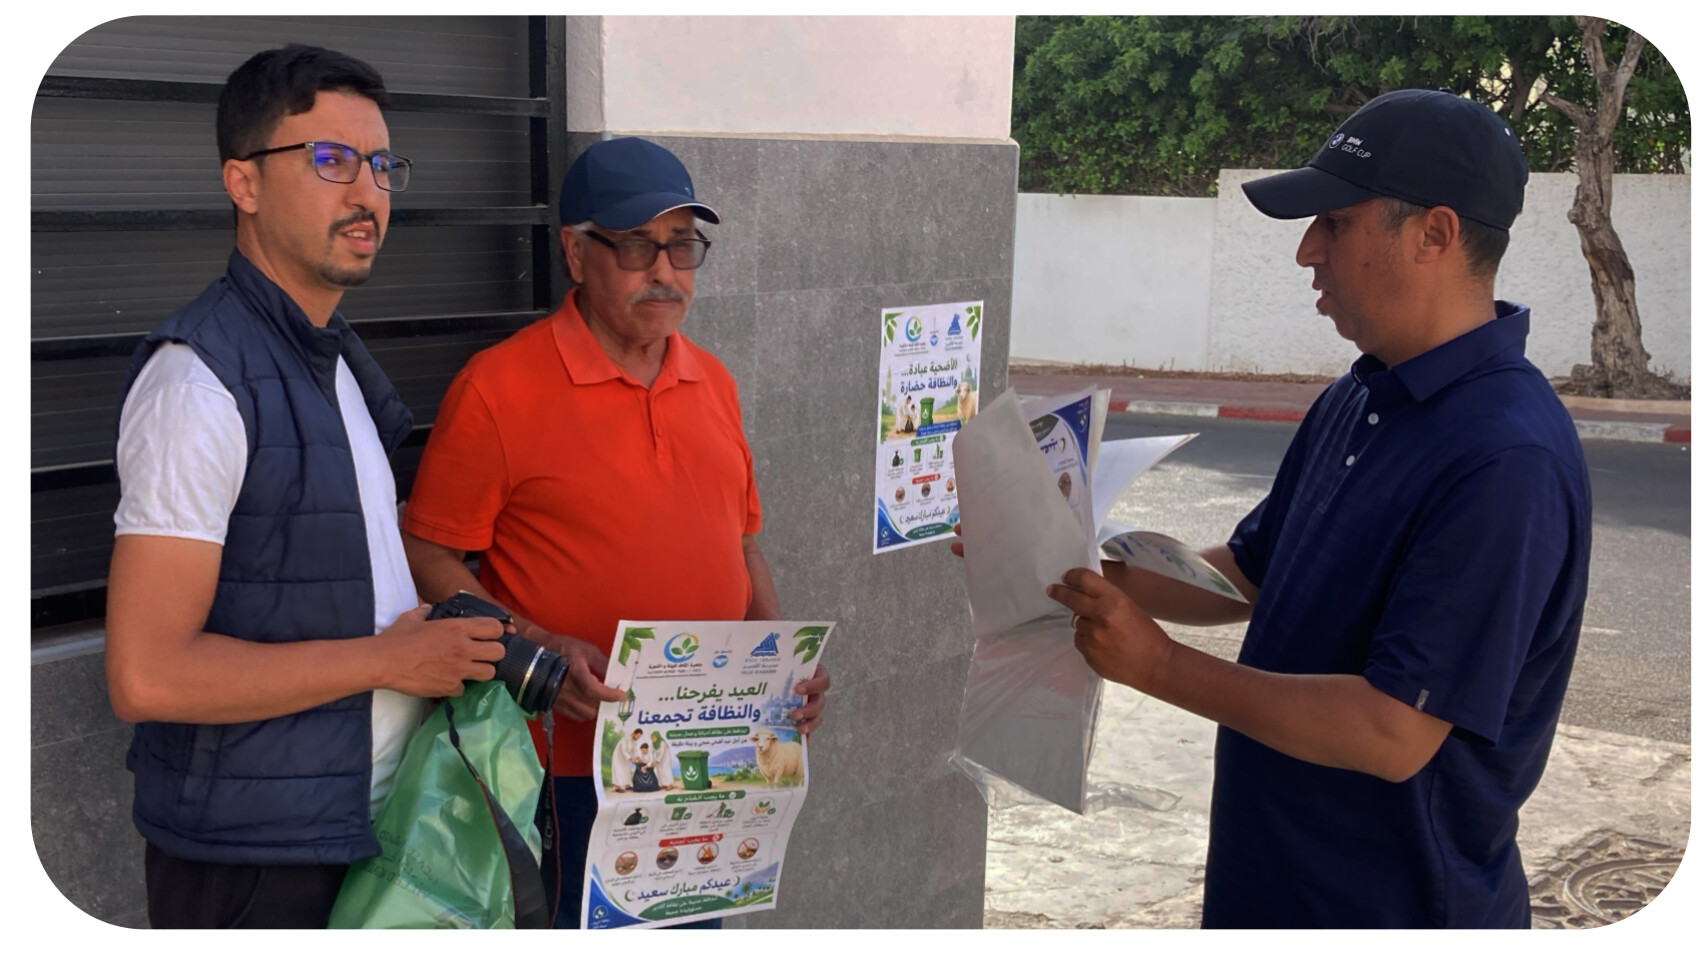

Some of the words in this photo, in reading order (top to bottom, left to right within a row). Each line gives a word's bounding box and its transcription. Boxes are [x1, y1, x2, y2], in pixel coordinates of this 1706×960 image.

[1341, 144, 1359, 153] GOLF
[1357, 149, 1372, 158] CUP
[900, 380, 926, 396] حضارة
[928, 376, 958, 389] والنظافة
[728, 682, 768, 701] العيد
[637, 708, 694, 727] تجمعنا
[697, 703, 761, 723] والنظافة
[670, 882, 698, 897] مبارك
[699, 877, 731, 894] عيدكم
[637, 888, 669, 902] سعيد
